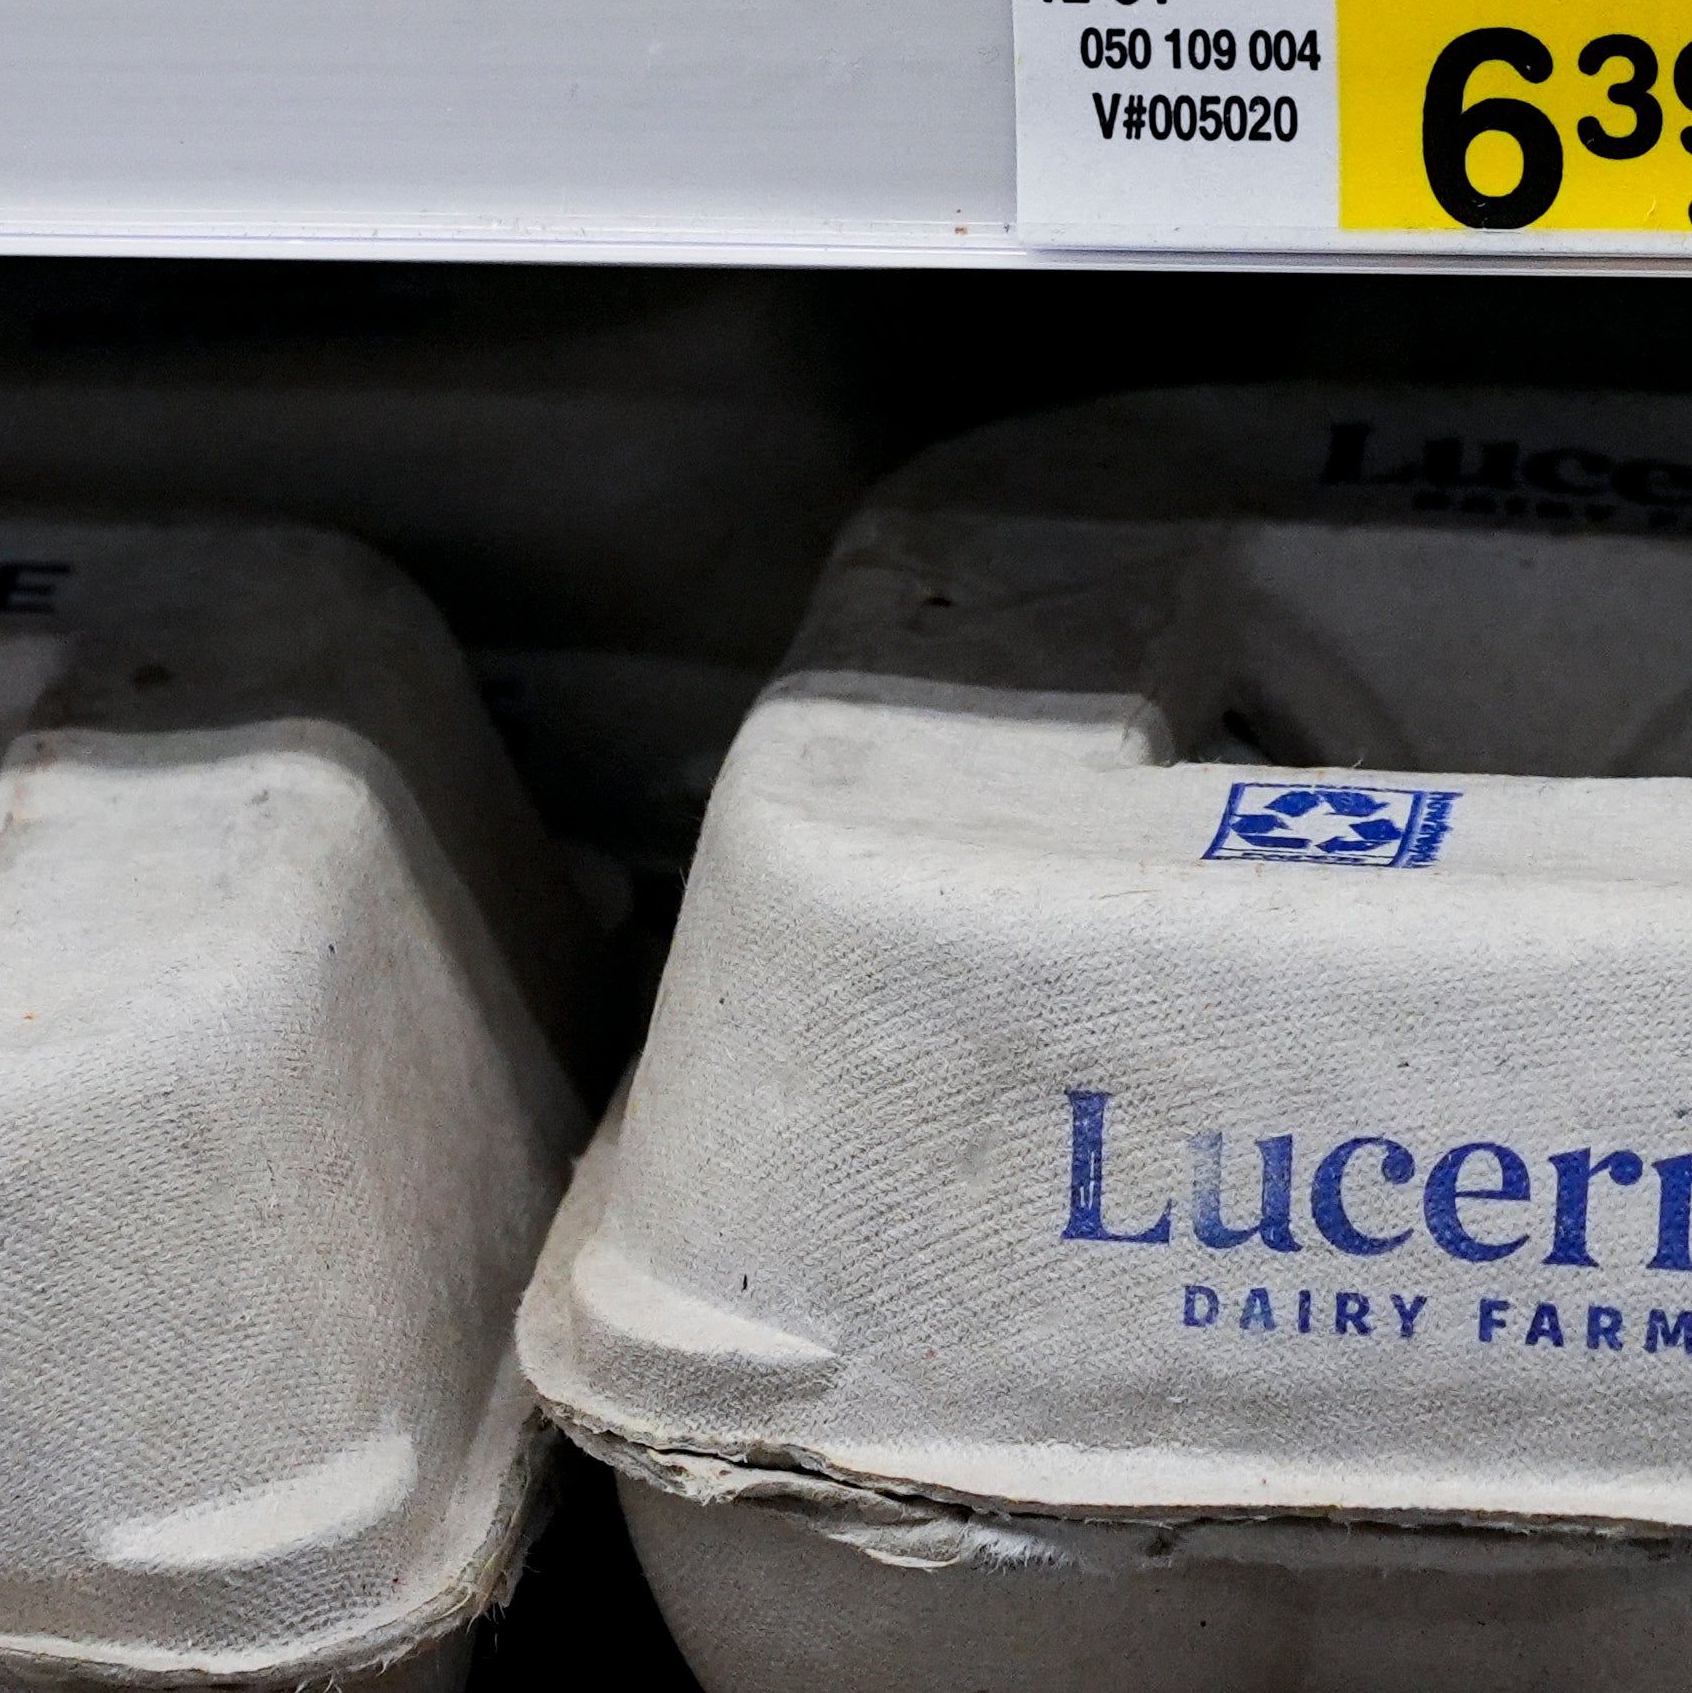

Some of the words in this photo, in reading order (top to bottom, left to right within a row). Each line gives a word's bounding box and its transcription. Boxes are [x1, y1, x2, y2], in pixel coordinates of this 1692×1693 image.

[1080, 28, 1152, 69] 050
[1164, 28, 1237, 70] 109
[1248, 29, 1321, 71] 004
[1092, 92, 1298, 142] V#005020
[1182, 1284, 1428, 1339] DAIRY
